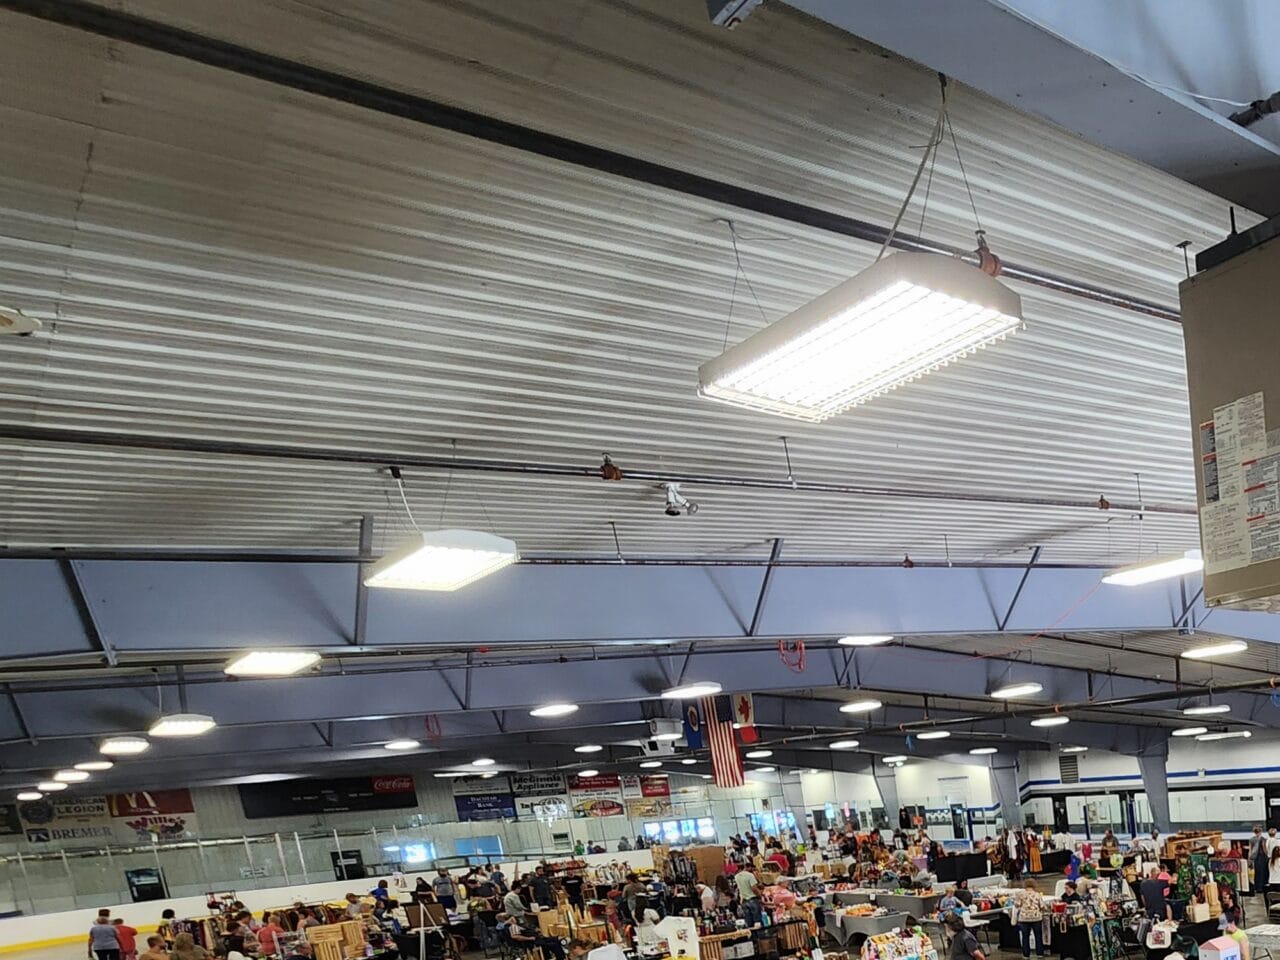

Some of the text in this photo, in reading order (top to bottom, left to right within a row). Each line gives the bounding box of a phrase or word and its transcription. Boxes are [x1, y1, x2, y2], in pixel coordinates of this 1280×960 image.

[516, 782, 560, 790] Appliance
[56, 804, 105, 814] LEGION
[51, 826, 112, 839] BREMER
